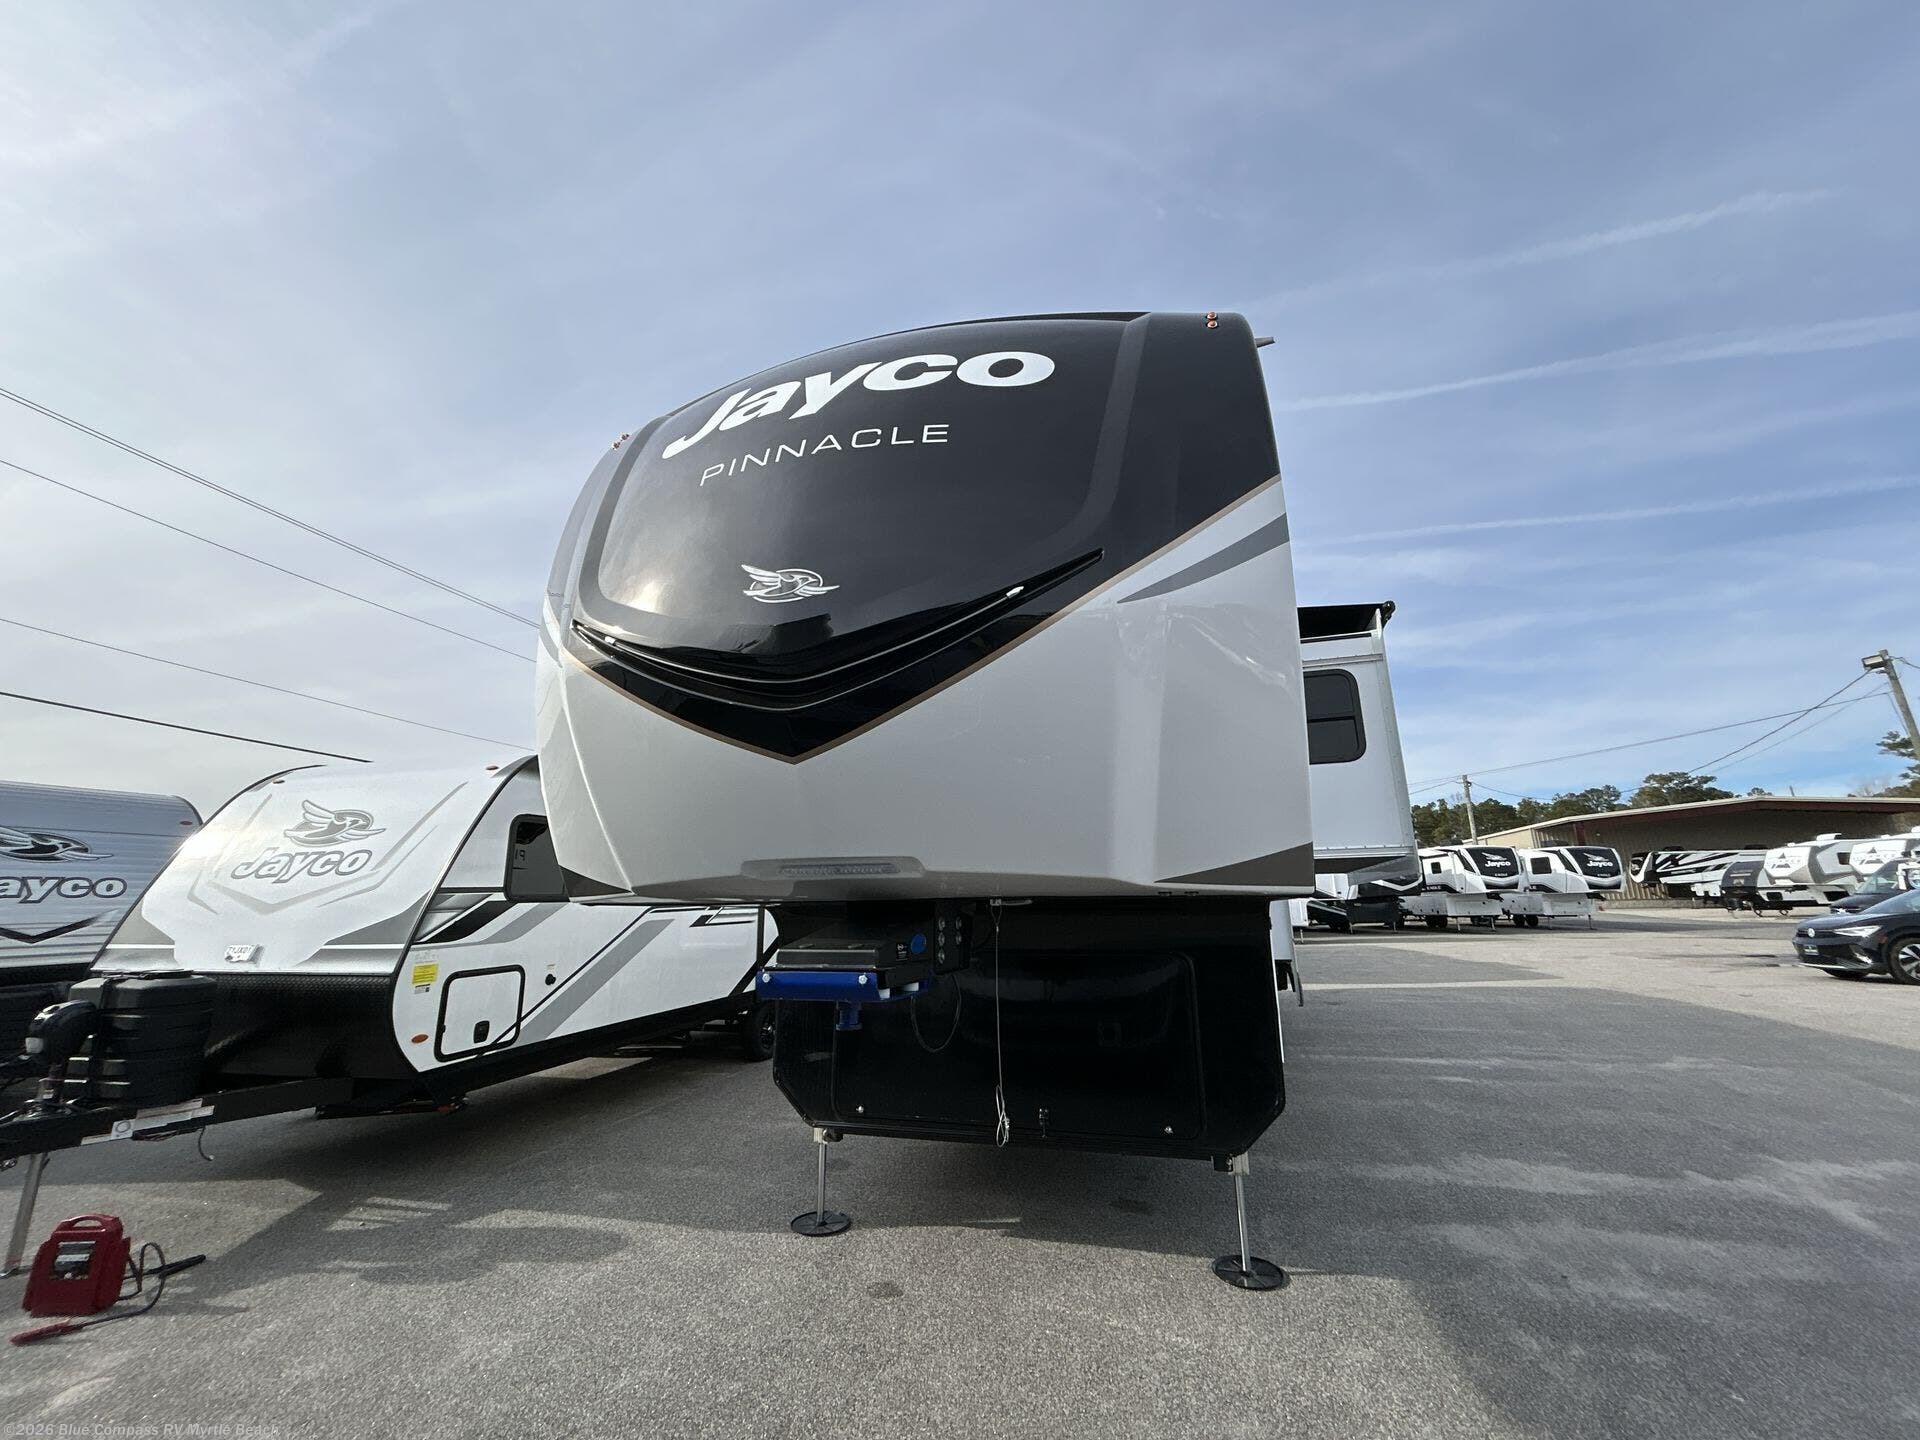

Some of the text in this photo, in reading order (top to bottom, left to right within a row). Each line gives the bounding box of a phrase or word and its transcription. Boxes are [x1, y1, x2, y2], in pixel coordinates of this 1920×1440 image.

[661, 351, 1056, 459] Jayco
[699, 424, 950, 486] PINNACLE
[231, 847, 373, 884] Jayco
